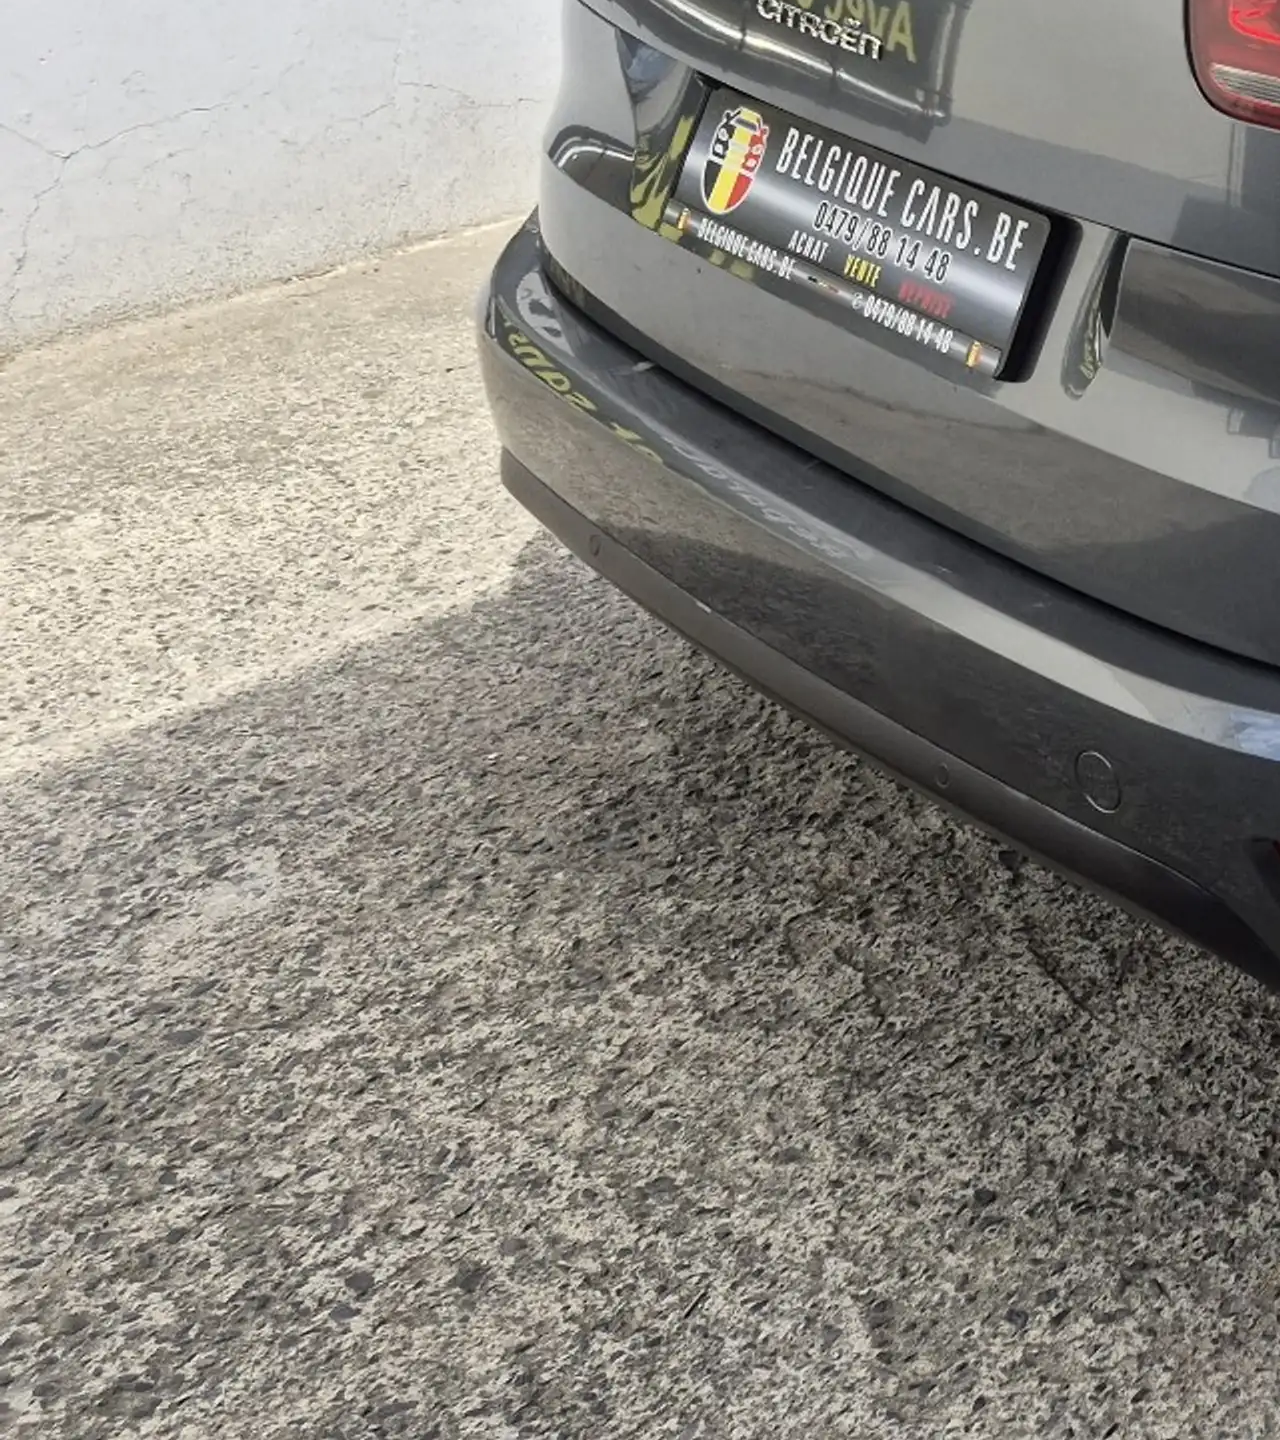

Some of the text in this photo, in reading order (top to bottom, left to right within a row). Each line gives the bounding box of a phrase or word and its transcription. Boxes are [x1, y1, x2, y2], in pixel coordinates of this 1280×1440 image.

[775, 127, 901, 217] BELGIQUE
[787, 229, 829, 262] ACHAT
[843, 253, 882, 288] VENTE
[812, 201, 953, 284] 0479/88 14 48
